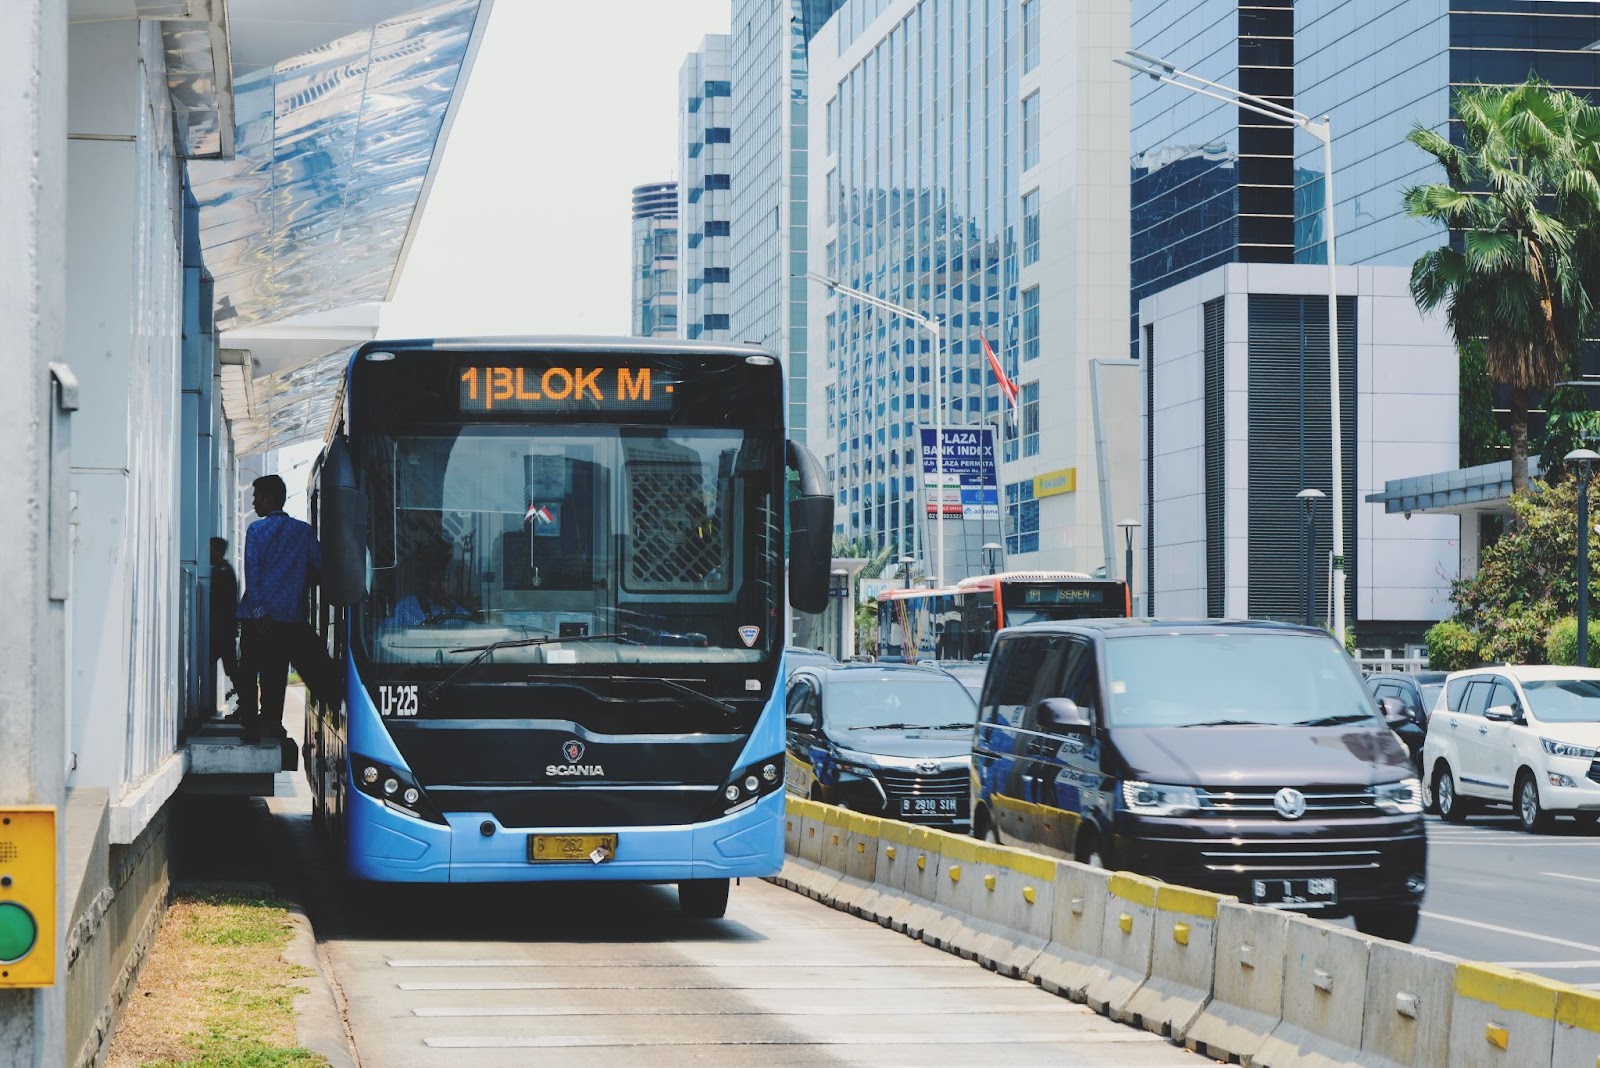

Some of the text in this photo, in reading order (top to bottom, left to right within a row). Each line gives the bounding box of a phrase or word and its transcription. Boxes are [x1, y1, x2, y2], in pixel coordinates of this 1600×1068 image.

[923, 446, 992, 455] BANK INDEX
[1059, 589, 1090, 600] SENEN
[378, 685, 418, 716] TJ-225
[545, 765, 605, 776] SCANIA
[903, 799, 910, 810] B
[537, 838, 545, 851] B
[1254, 881, 1267, 897] B
